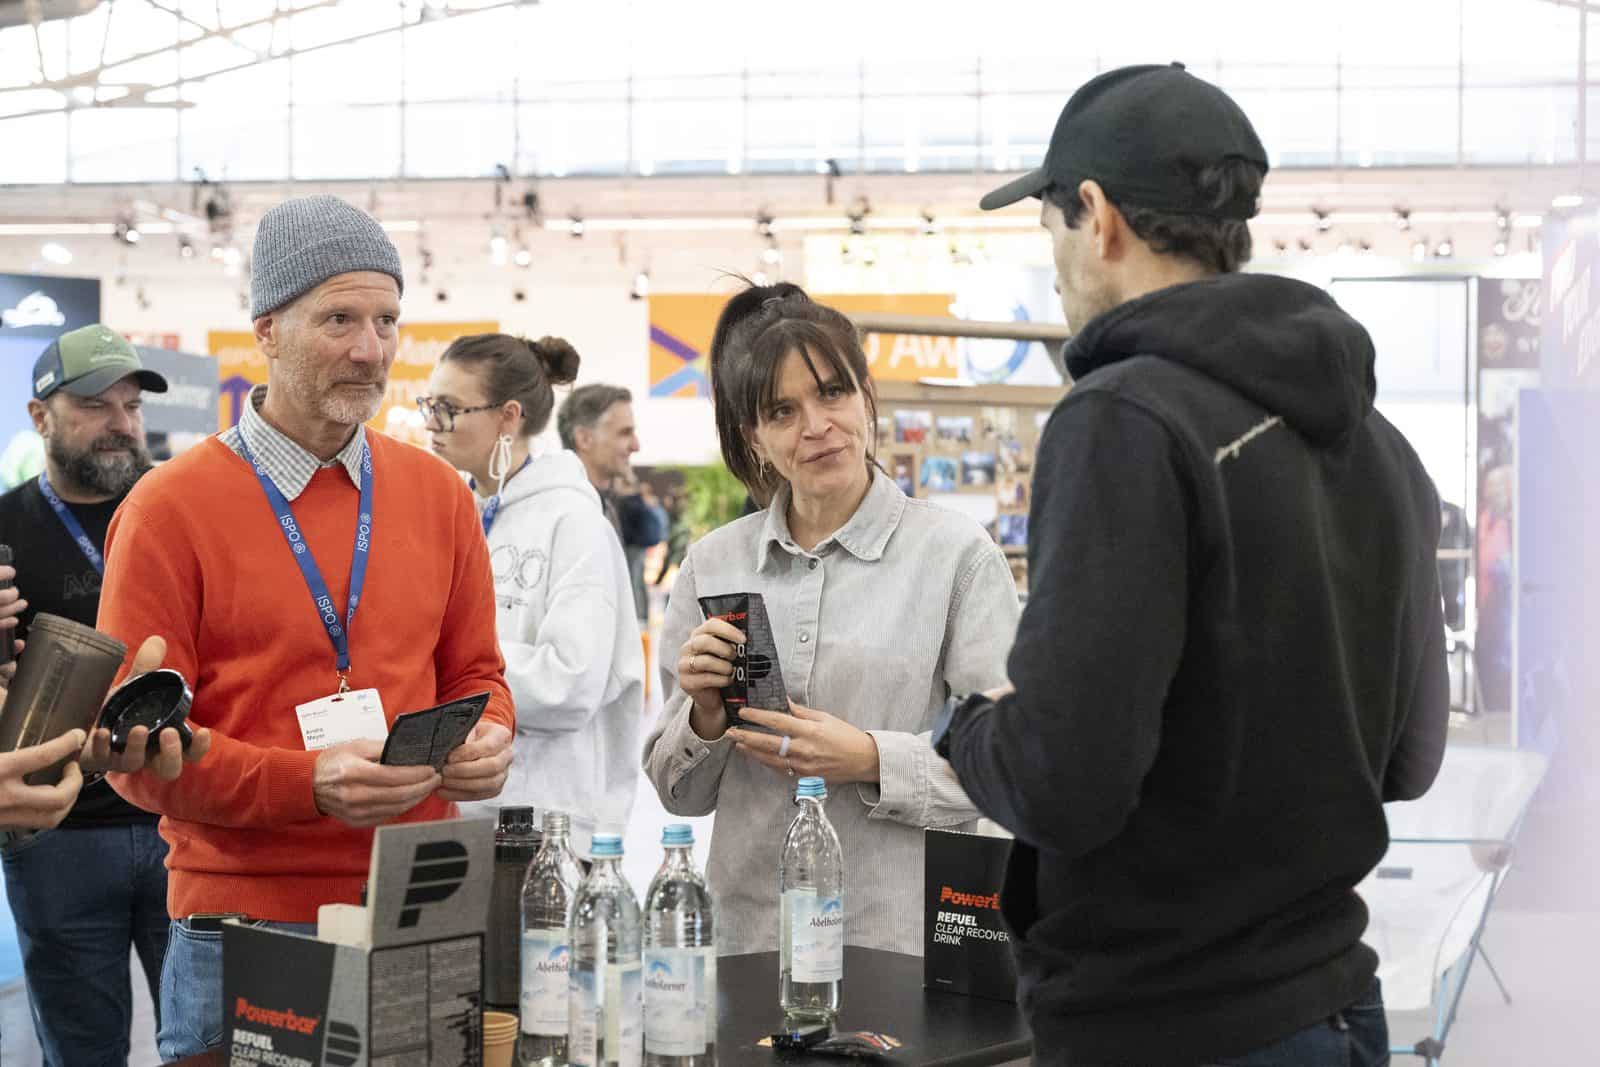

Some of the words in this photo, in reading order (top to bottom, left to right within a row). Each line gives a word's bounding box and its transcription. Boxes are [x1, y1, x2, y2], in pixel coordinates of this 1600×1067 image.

[280, 514, 300, 542] ISPO
[357, 524, 370, 552] ISPO
[317, 595, 336, 624] ISPO
[935, 923, 965, 936] CLEAR
[937, 911, 978, 927] REFUEL
[934, 933, 962, 946] DRINK
[235, 997, 318, 1035] Powerbar
[233, 1028, 273, 1050] REFUEL
[231, 1044, 261, 1062] CLEAR
